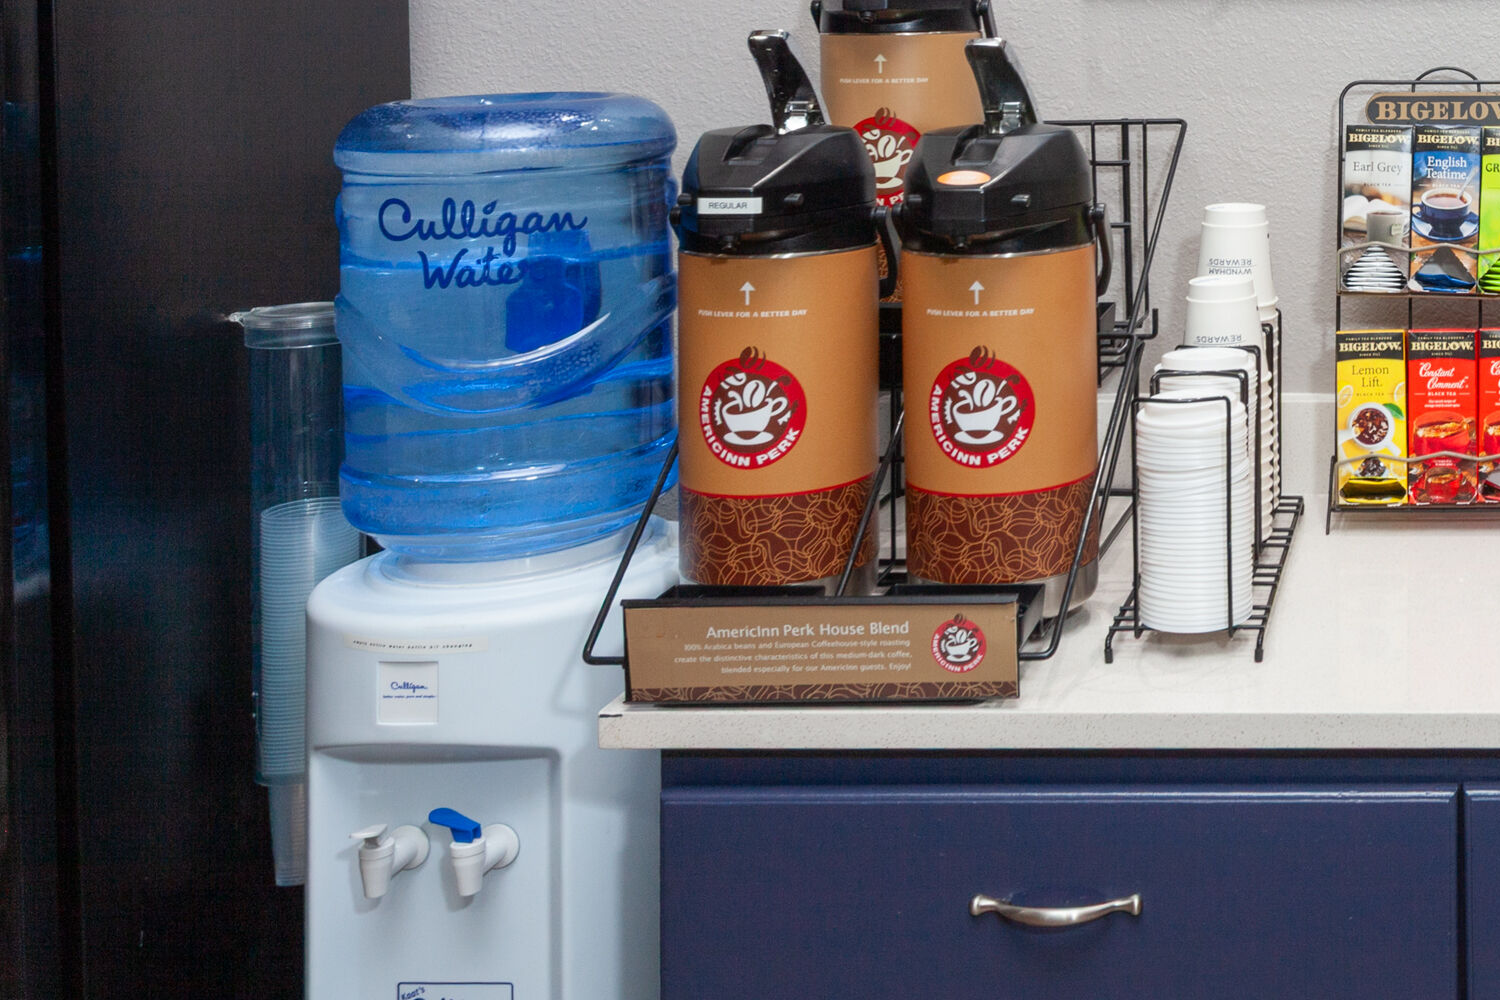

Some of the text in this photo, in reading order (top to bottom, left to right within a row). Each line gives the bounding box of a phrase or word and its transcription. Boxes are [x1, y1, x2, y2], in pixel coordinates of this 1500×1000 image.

[1353, 161, 1403, 176] Earl Grey
[1427, 156, 1467, 169] English
[708, 201, 748, 209] REGULAR
[378, 197, 588, 257] Culligan
[417, 247, 530, 289] Water
[1208, 258, 1252, 266] REWARDS
[1208, 267, 1252, 275] WYNDHAM
[1196, 334, 1242, 343] REWARDS
[1351, 365, 1389, 375] Lemon
[701, 385, 801, 467] AMERICINN PERK
[931, 384, 1029, 466] AMERICINN PERK
[706, 621, 910, 639] AmericInn Perk House Blend
[713, 654, 752, 662] distinctive
[754, 652, 808, 661] characteristics
[836, 651, 885, 659] medium-dark
[721, 665, 751, 674] blended
[753, 664, 790, 673] especially
[820, 663, 859, 671] AmericInn
[390, 681, 428, 693] Culligan
